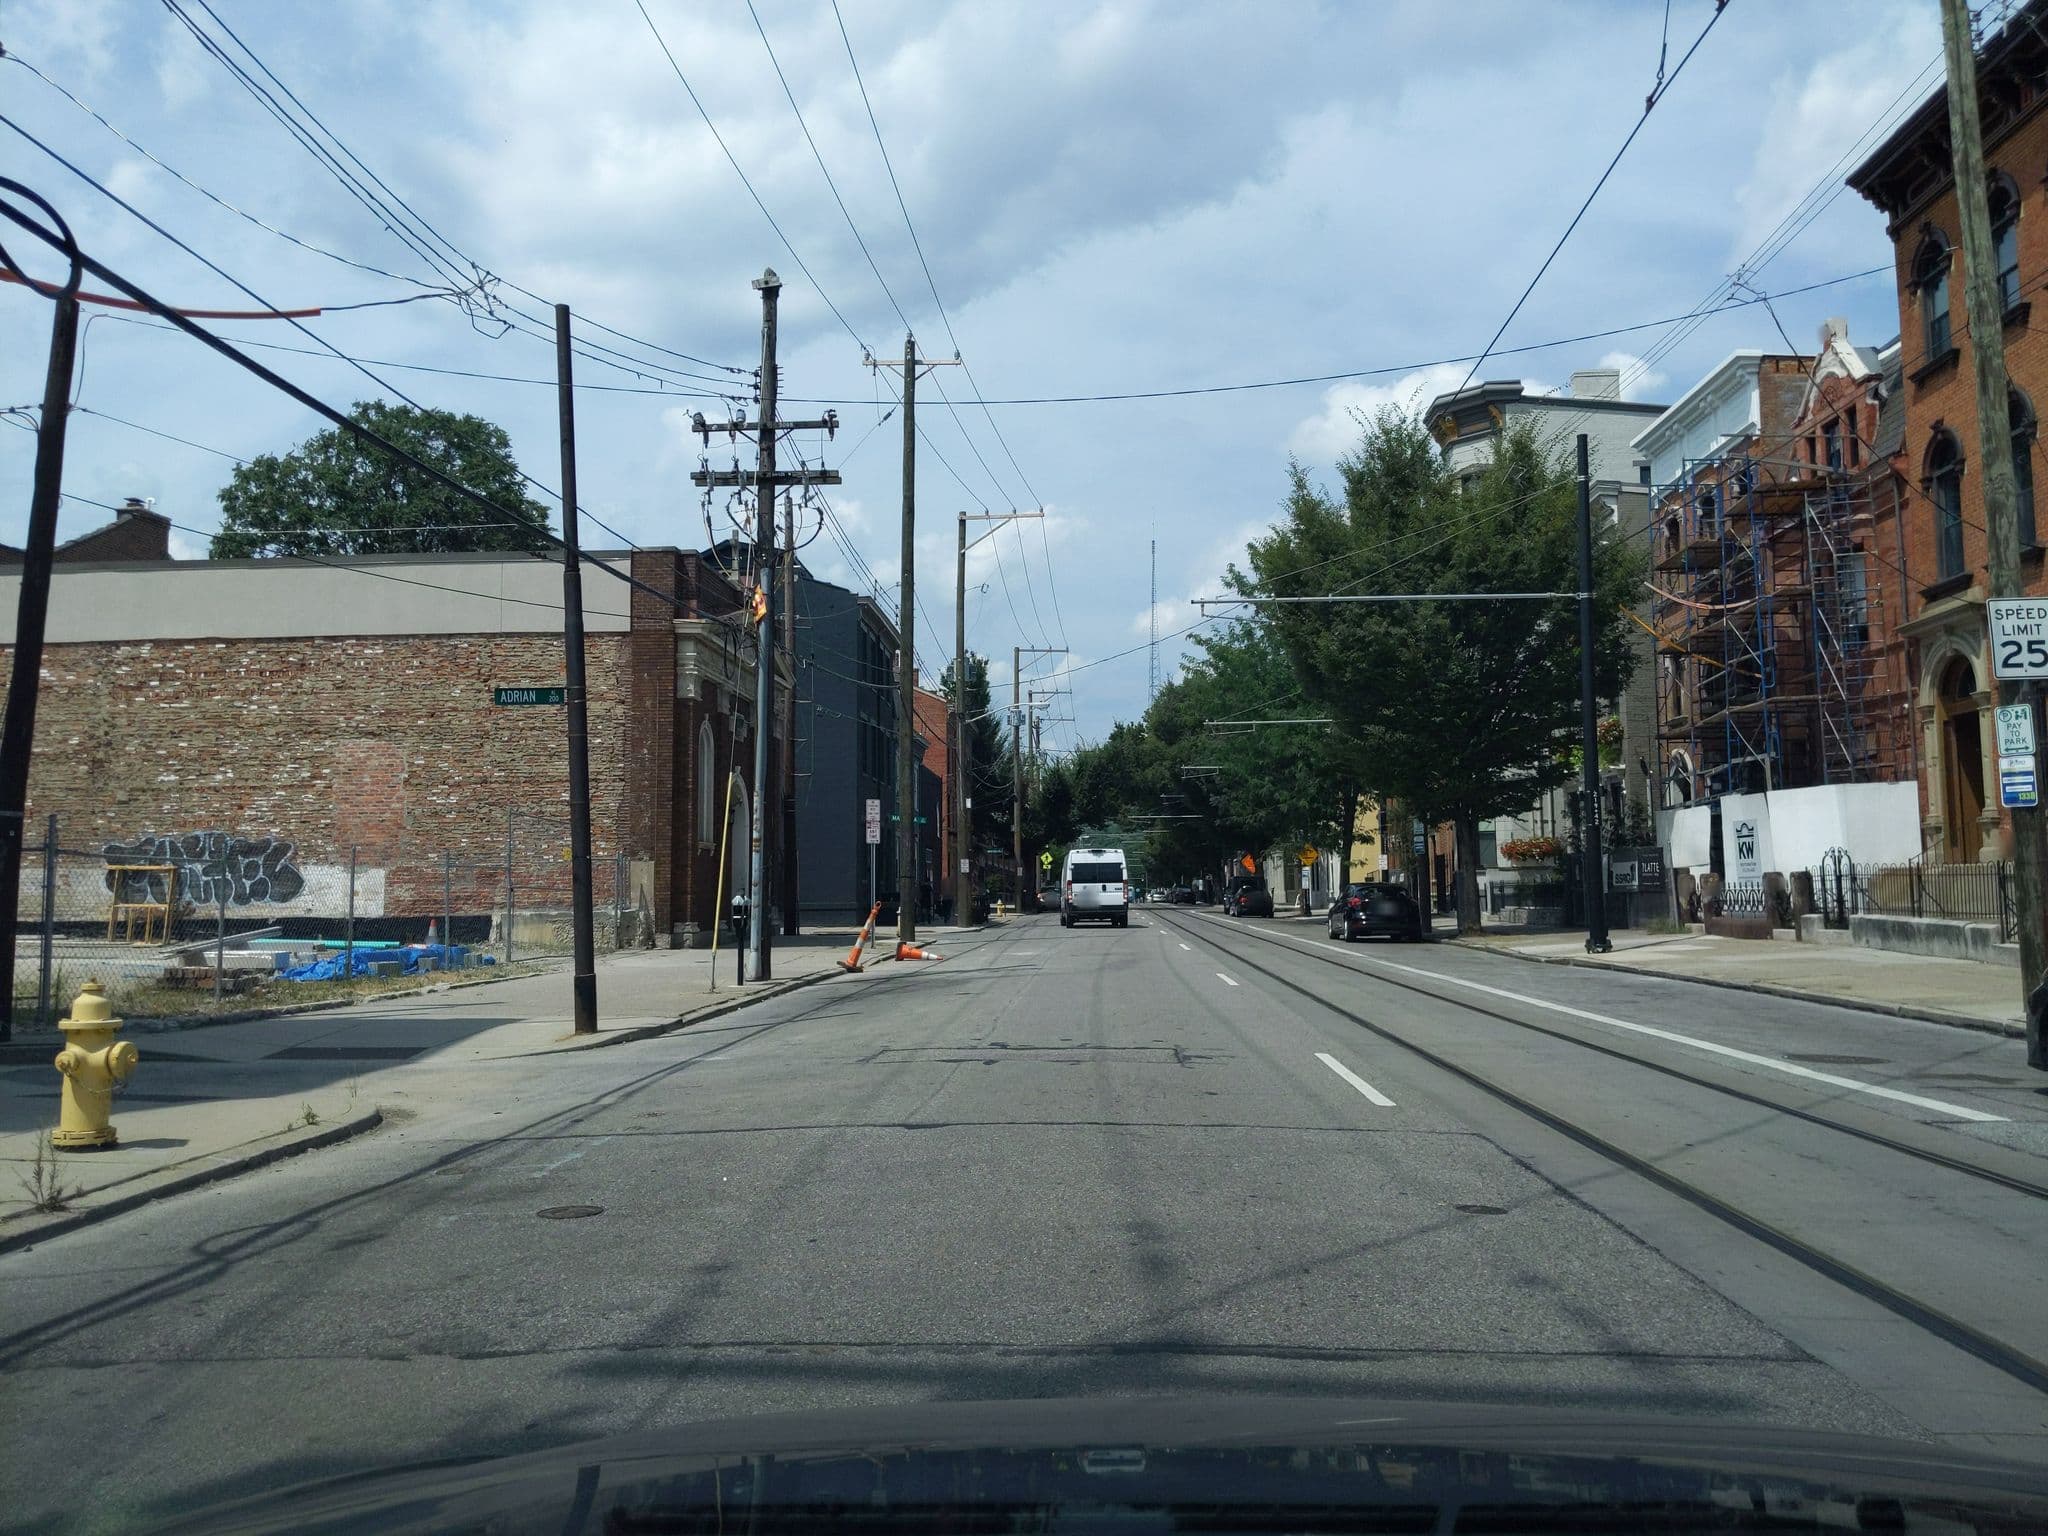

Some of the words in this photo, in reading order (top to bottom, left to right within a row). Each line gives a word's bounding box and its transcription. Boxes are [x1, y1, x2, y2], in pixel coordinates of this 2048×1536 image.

[1994, 607, 2048, 620] SPEED
[2001, 623, 2042, 636] LIMIT
[2000, 639, 2048, 669] 25
[500, 690, 536, 703] ADRIAN
[2006, 722, 2022, 730] PAY
[2004, 737, 2027, 745] PARK
[1737, 840, 1754, 860] KW
